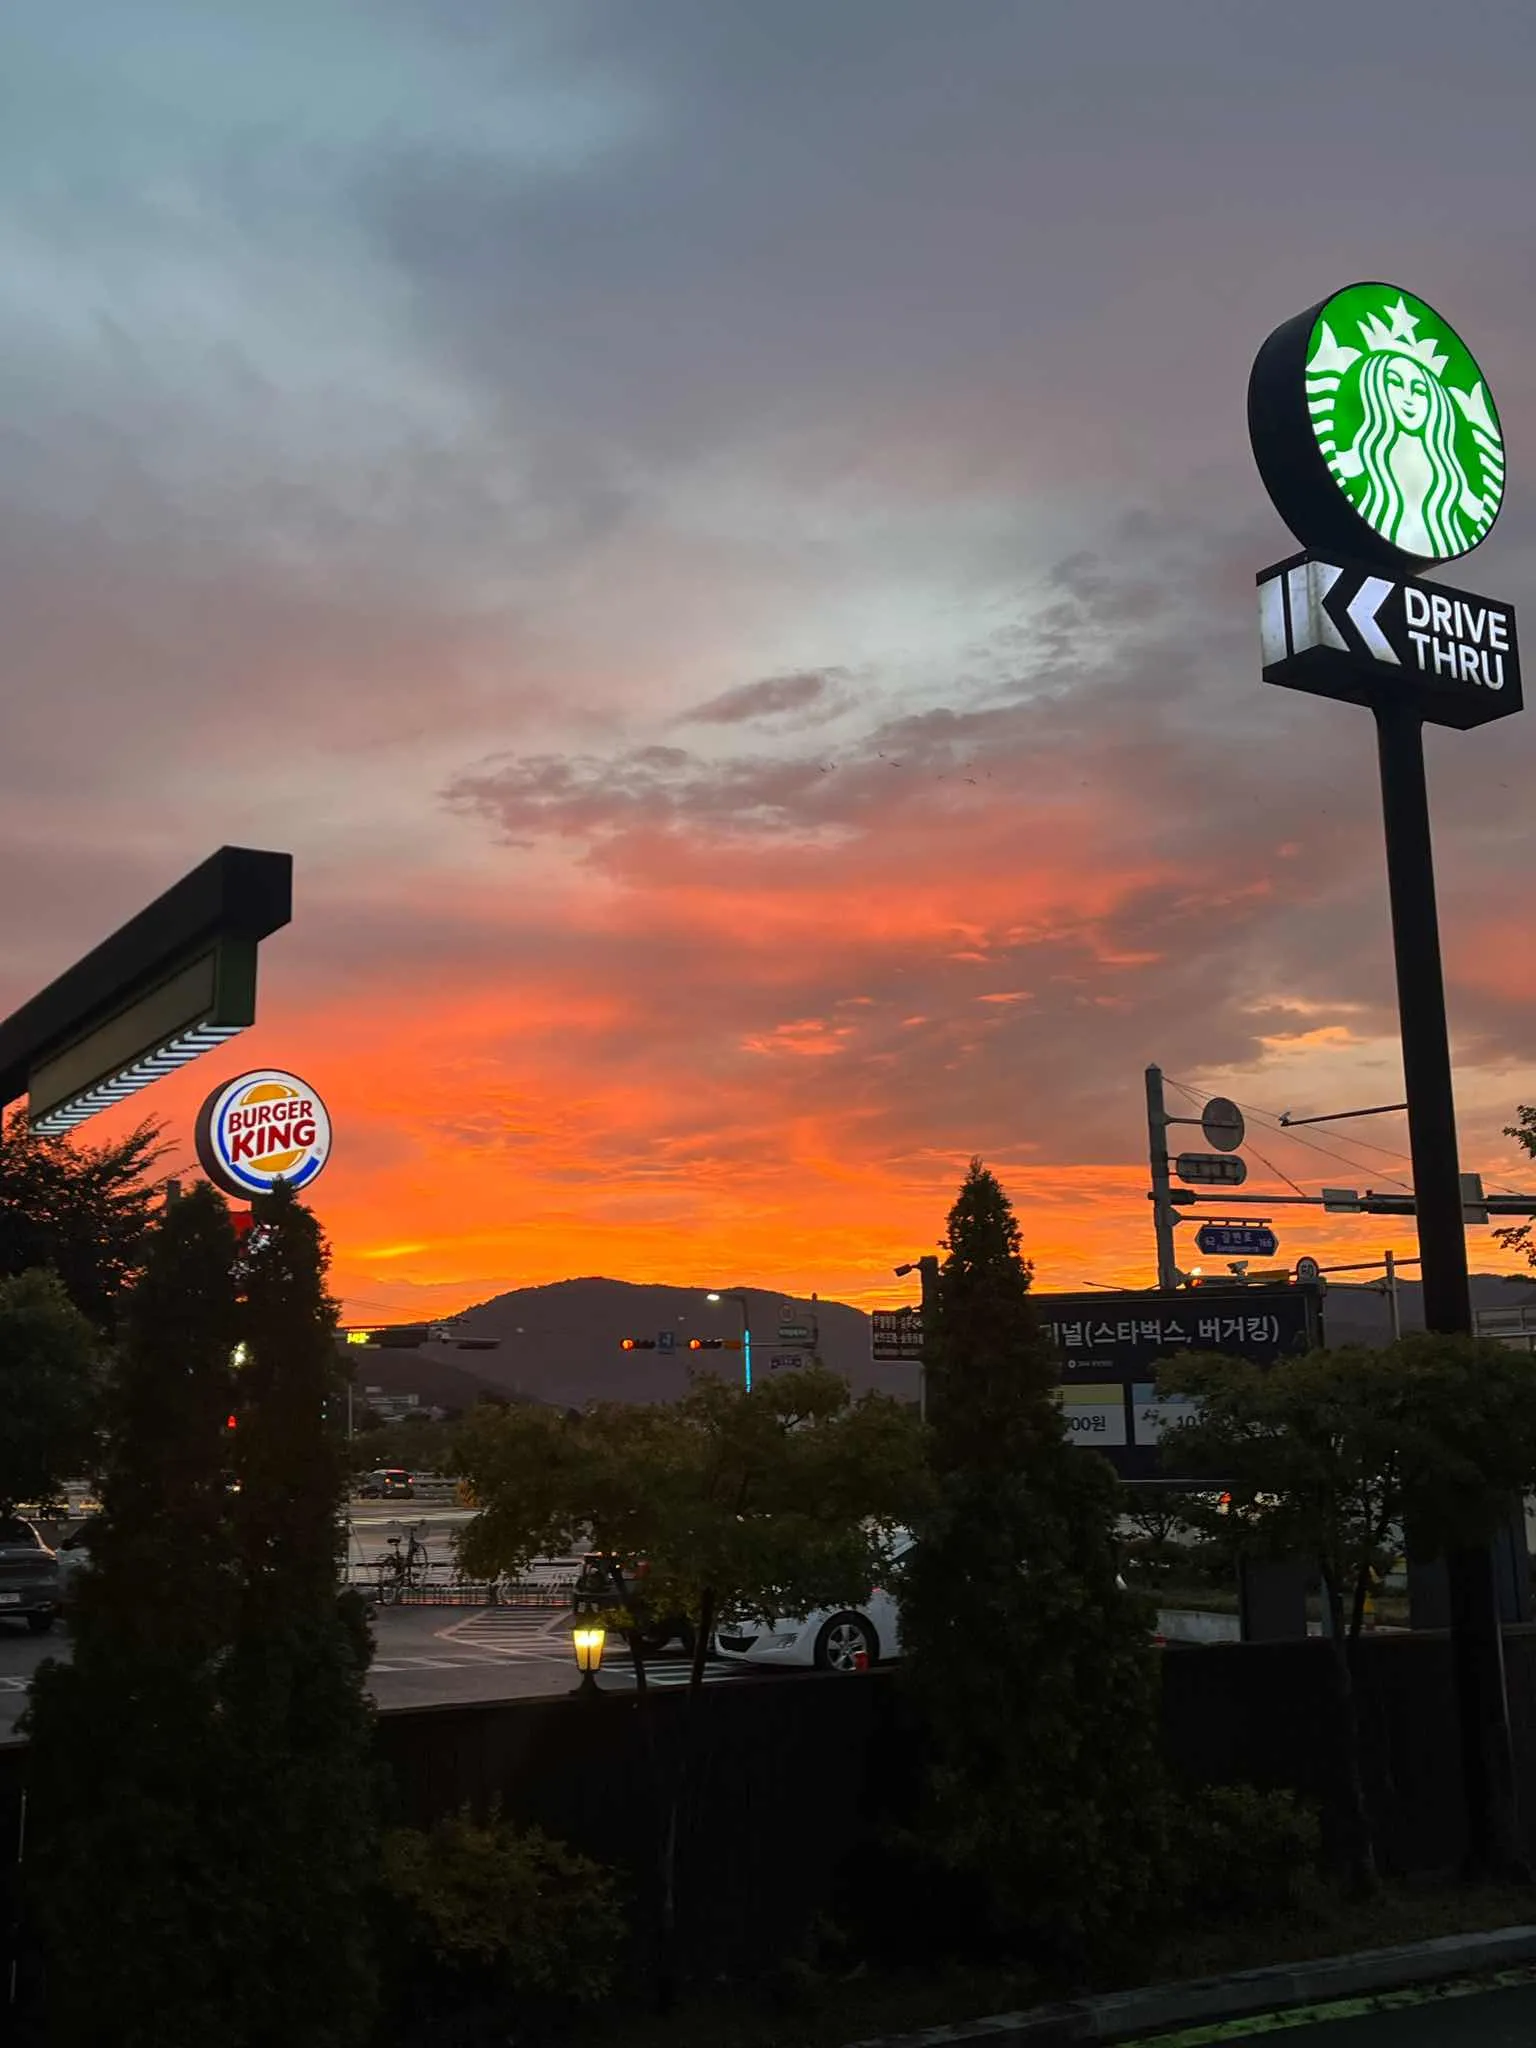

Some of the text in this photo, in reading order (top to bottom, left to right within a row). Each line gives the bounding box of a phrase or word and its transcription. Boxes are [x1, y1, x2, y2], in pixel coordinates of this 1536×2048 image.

[1404, 587, 1510, 651] DRIVE
[1408, 630, 1505, 690] THRU
[229, 1100, 312, 1133] BURGER
[232, 1120, 315, 1162] KING
[1198, 1315, 1281, 1343] 버거킹)
[1069, 1415, 1106, 1432] 00원
